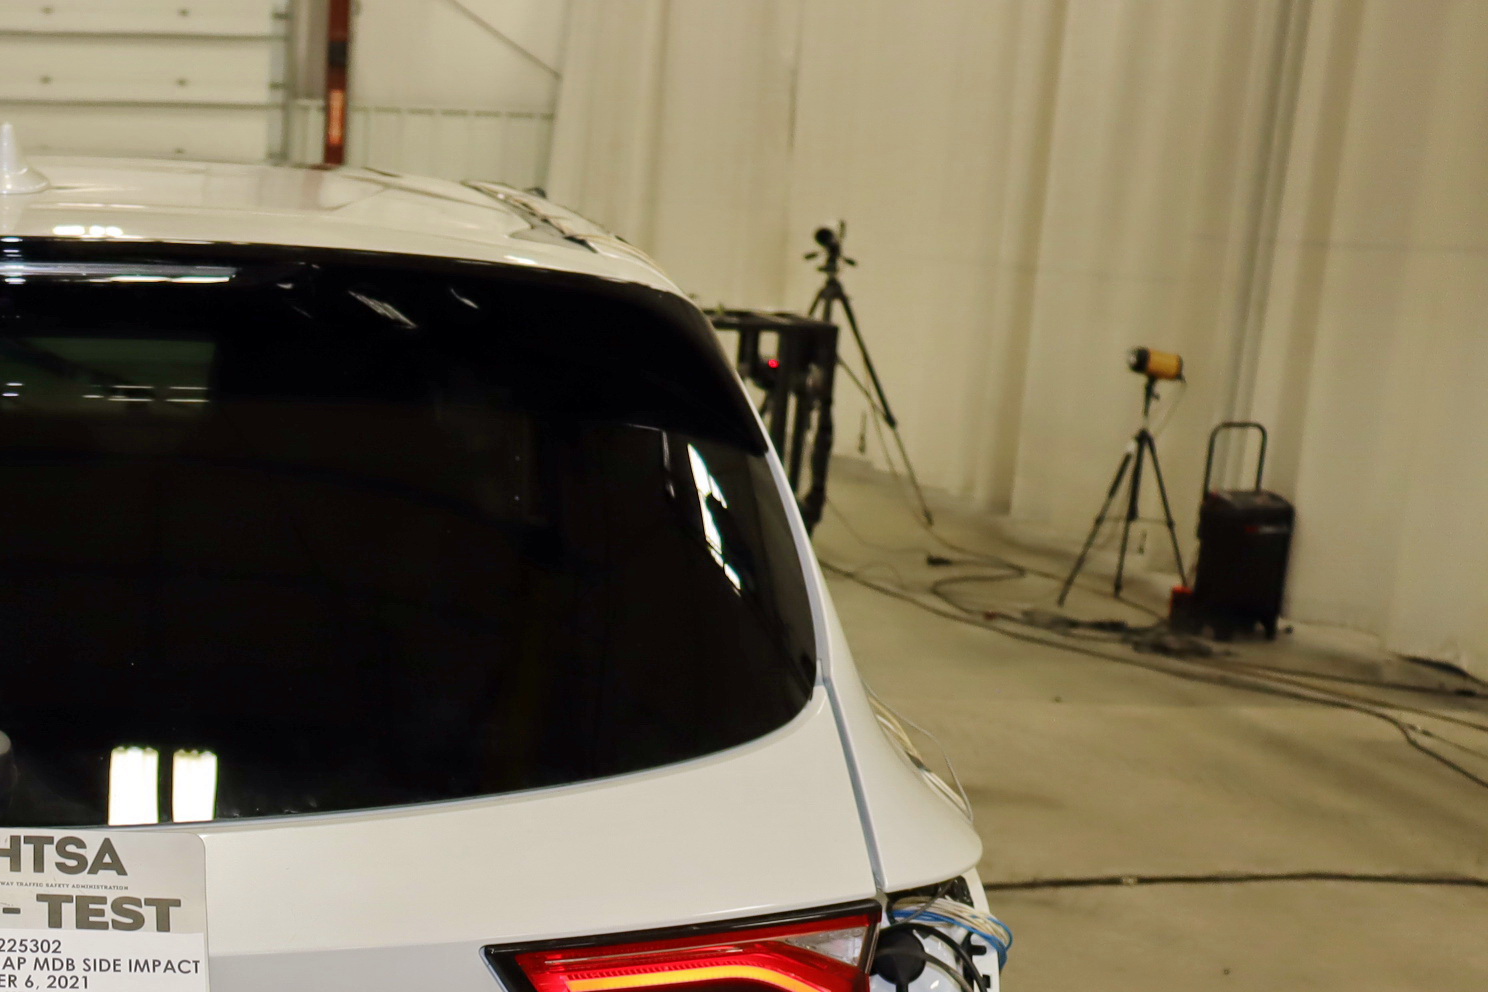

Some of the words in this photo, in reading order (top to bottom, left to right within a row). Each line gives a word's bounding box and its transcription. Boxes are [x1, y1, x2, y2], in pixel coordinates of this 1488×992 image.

[36, 894, 181, 932] TEST
[34, 957, 75, 971] MDB
[83, 958, 121, 972] SIDE
[129, 959, 200, 974] IMPACT
[25, 975, 39, 990] 6,
[47, 975, 87, 989] 2021
